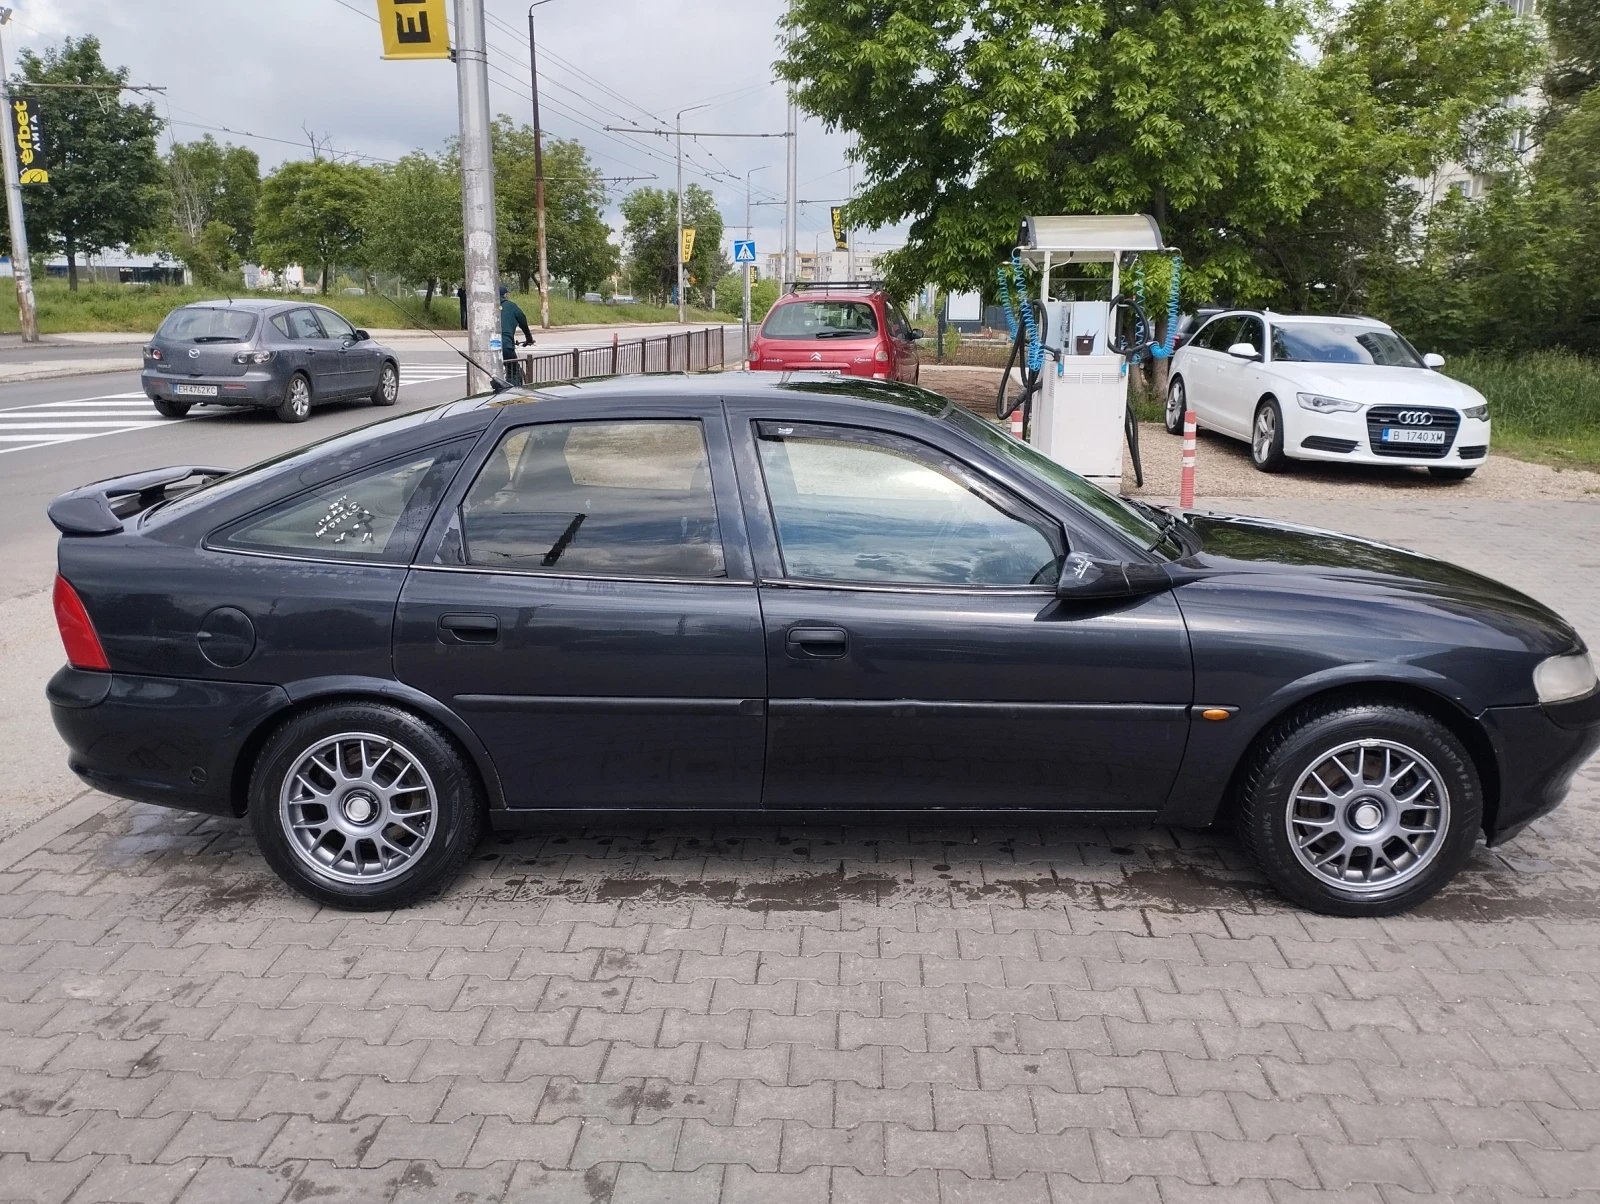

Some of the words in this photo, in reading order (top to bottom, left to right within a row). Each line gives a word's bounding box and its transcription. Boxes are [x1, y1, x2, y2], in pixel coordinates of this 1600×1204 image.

[178, 385, 188, 393] EH
[206, 387, 216, 395] KC
[1393, 431, 1400, 440] B
[1406, 431, 1429, 442] 1740
[1430, 432, 1443, 442] XM
[329, 512, 353, 528] OPEL
[335, 711, 386, 724] VECTOR
[1423, 731, 1474, 802] GOODYEAR
